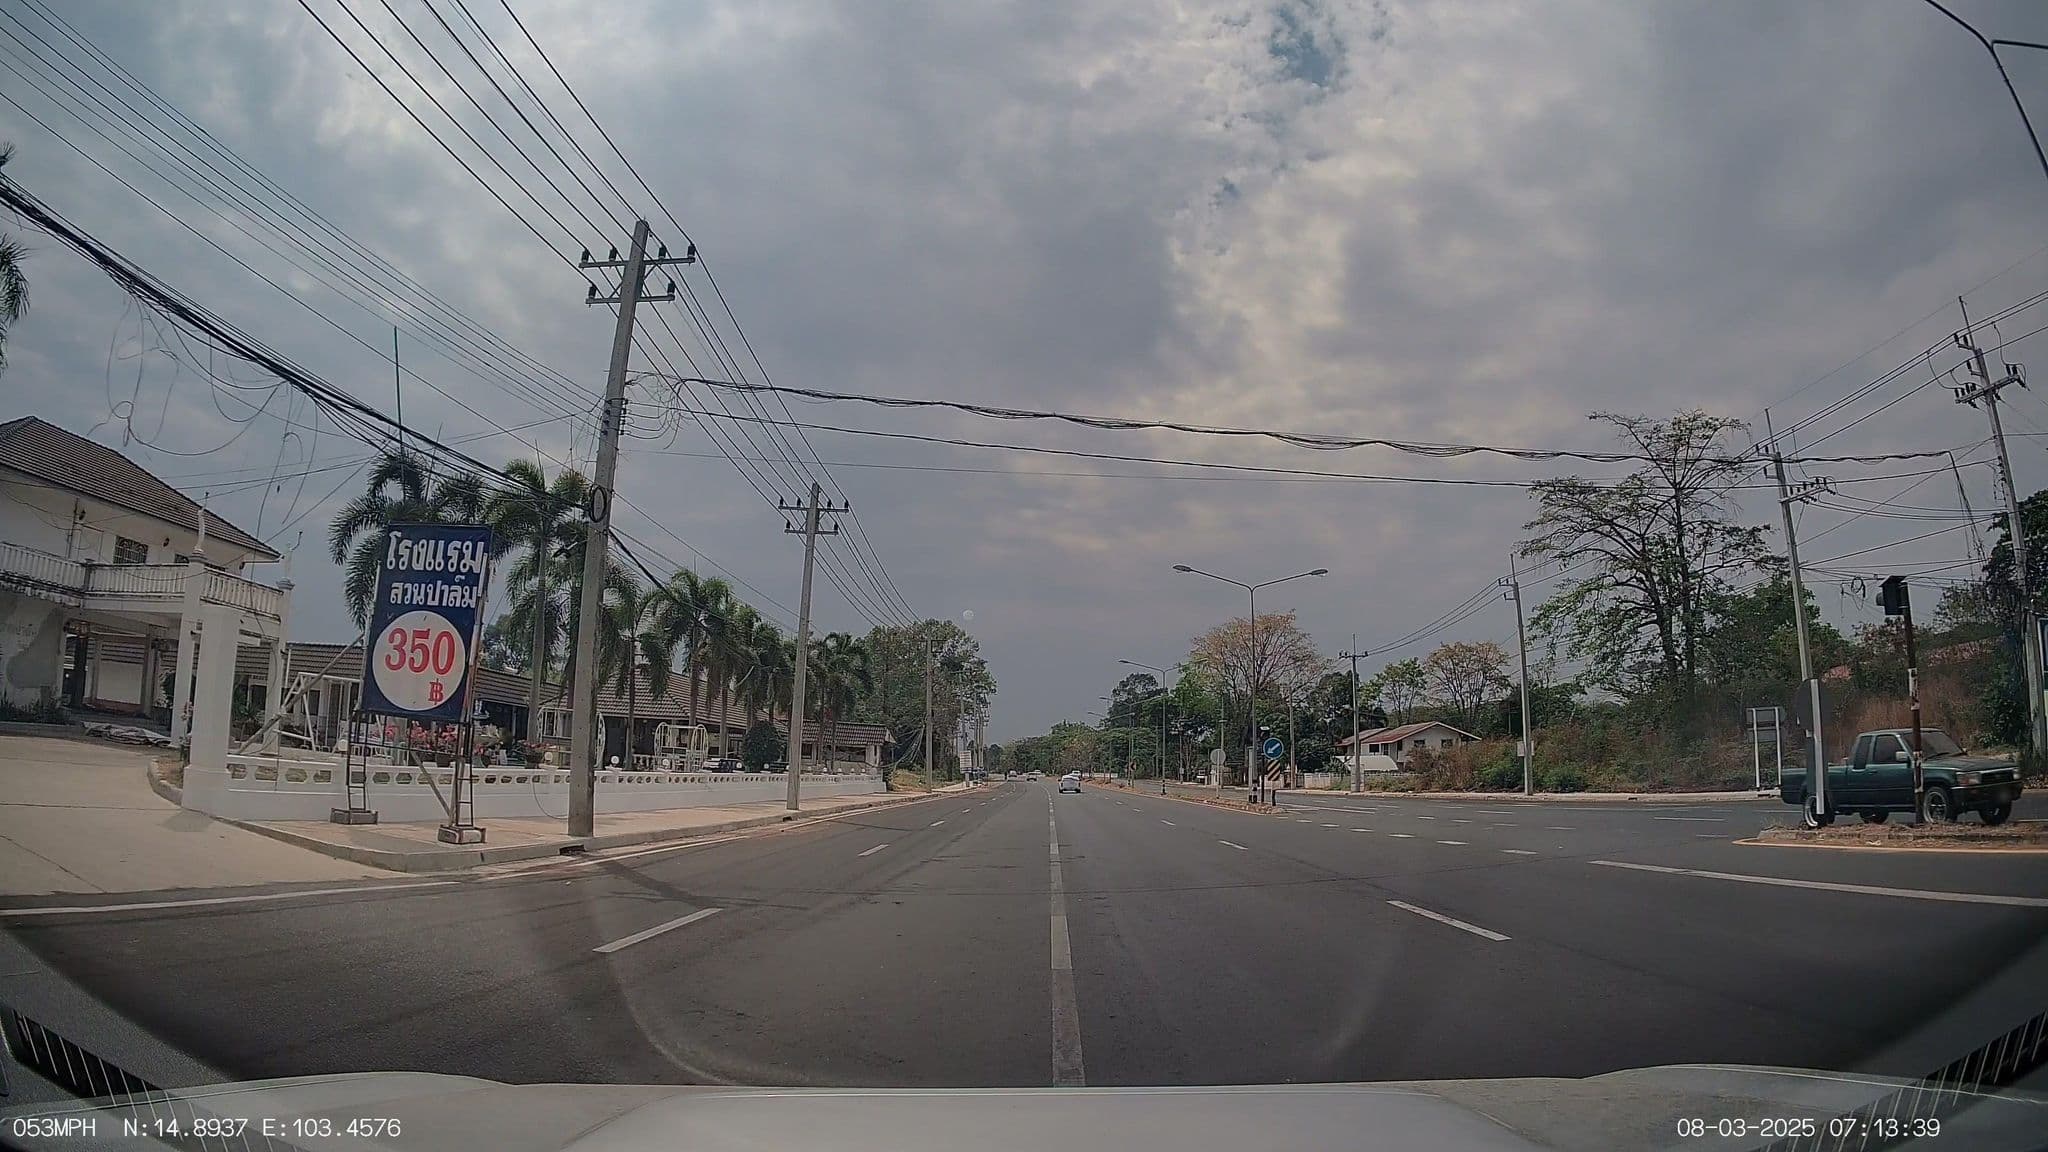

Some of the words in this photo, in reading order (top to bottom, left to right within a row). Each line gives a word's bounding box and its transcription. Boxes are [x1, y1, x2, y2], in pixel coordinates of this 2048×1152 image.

[386, 531, 484, 574] โรงแรม
[390, 575, 477, 608] สวนปาล์ม
[384, 627, 456, 676] 350
